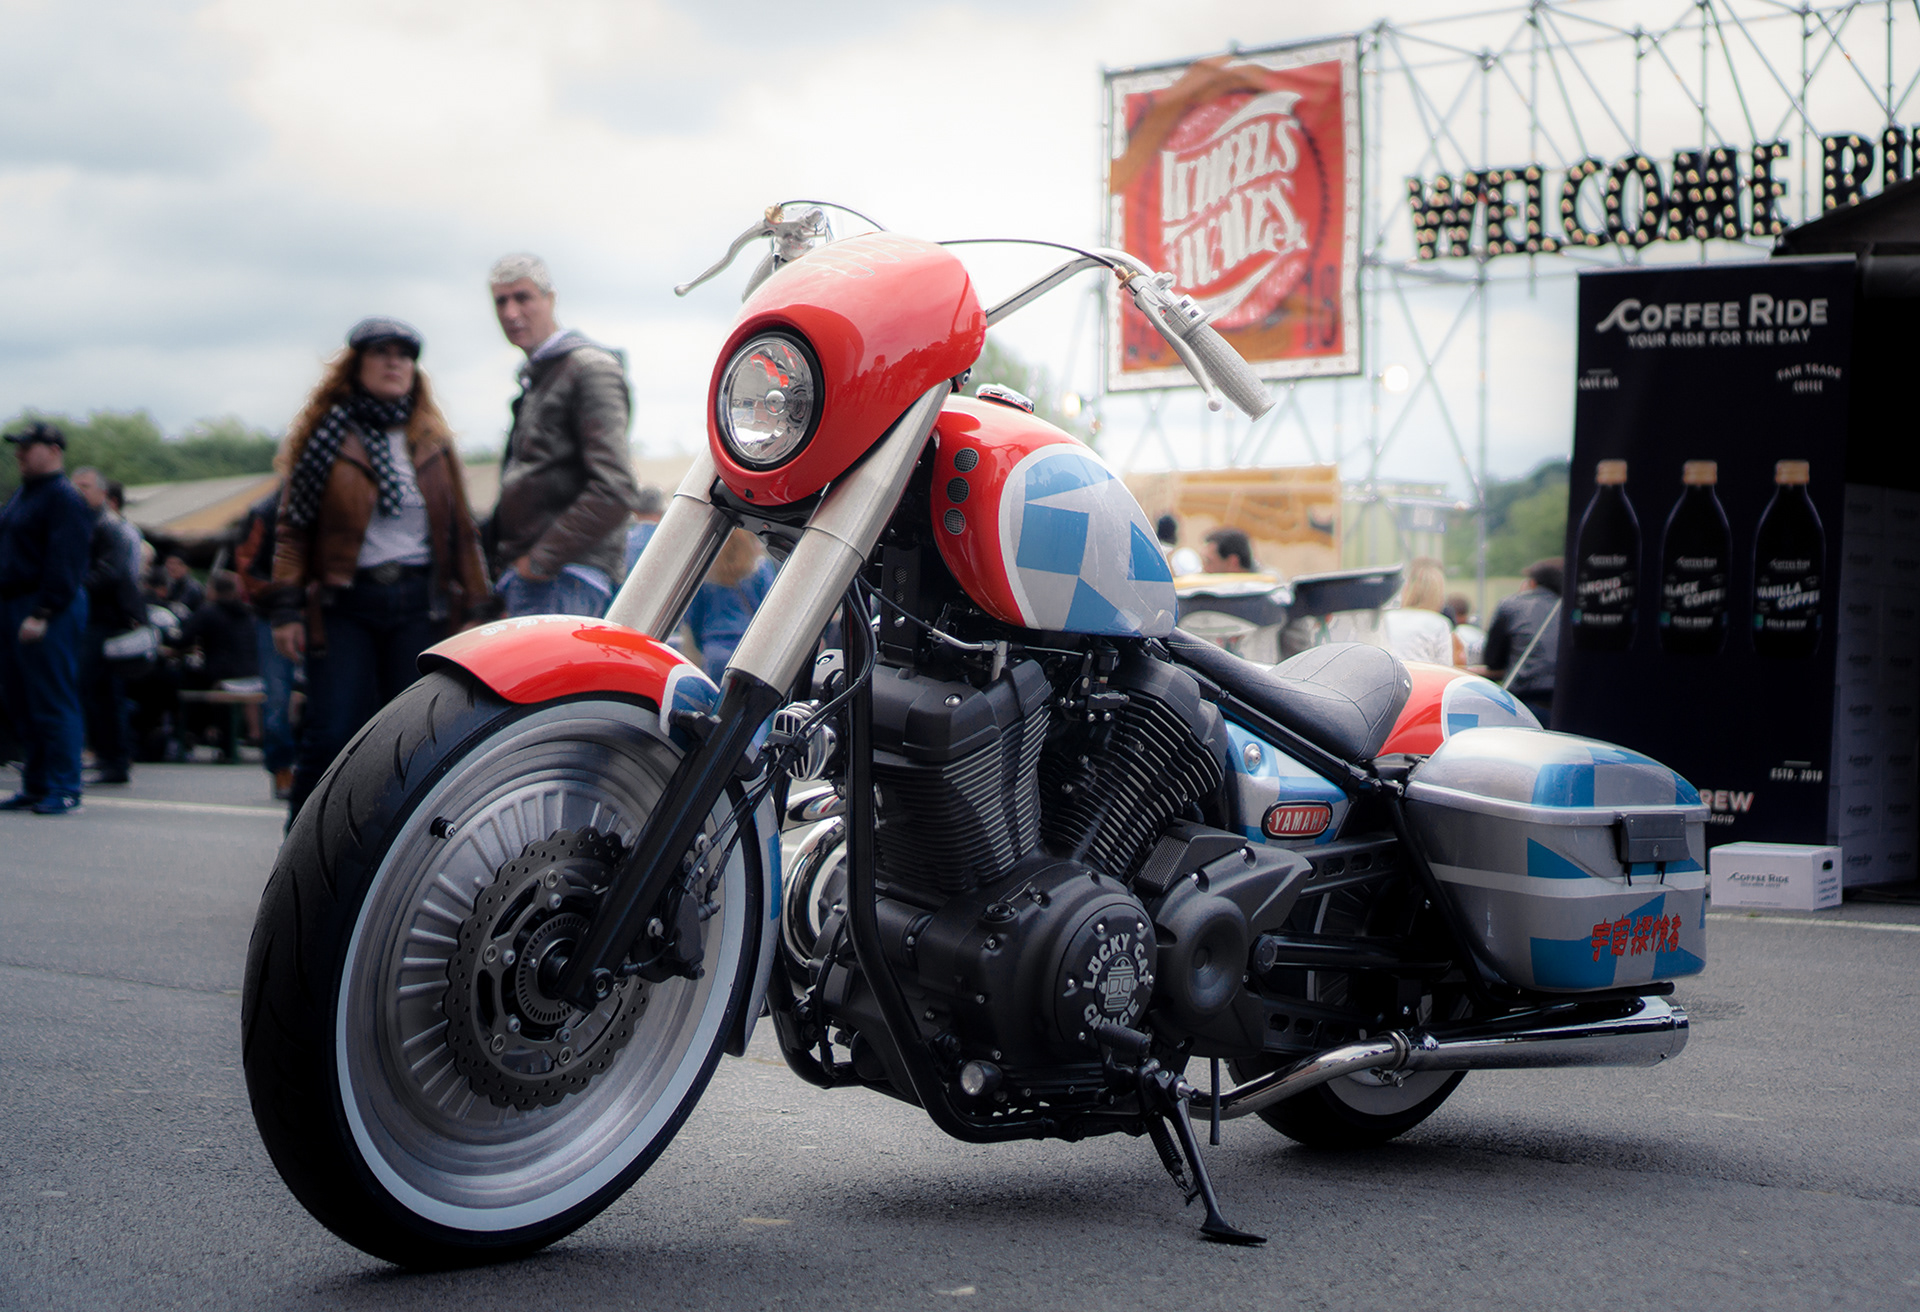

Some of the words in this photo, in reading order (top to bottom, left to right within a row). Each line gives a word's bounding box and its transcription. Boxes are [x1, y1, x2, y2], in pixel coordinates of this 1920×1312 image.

[1404, 140, 1788, 260] WELCOME
[1822, 127, 1920, 212] RI
[1596, 298, 1740, 332] COFFEE
[1748, 293, 1829, 327] RIDE
[1627, 332, 1667, 348] YOUR
[1670, 331, 1706, 347] RIDE
[1709, 330, 1742, 346] FOR
[1745, 329, 1774, 345] THE
[1777, 328, 1811, 344] DAY
[1804, 362, 1842, 380] TRADE
[1757, 581, 1802, 600] VANILLA
[1699, 788, 1755, 813] REW
[1274, 811, 1327, 831] YAMAHA
[1710, 814, 1736, 826] ROID
[1082, 933, 1131, 990] LUCKY
[1134, 941, 1150, 986] CAT
[1084, 998, 1140, 1030] GARAGE
